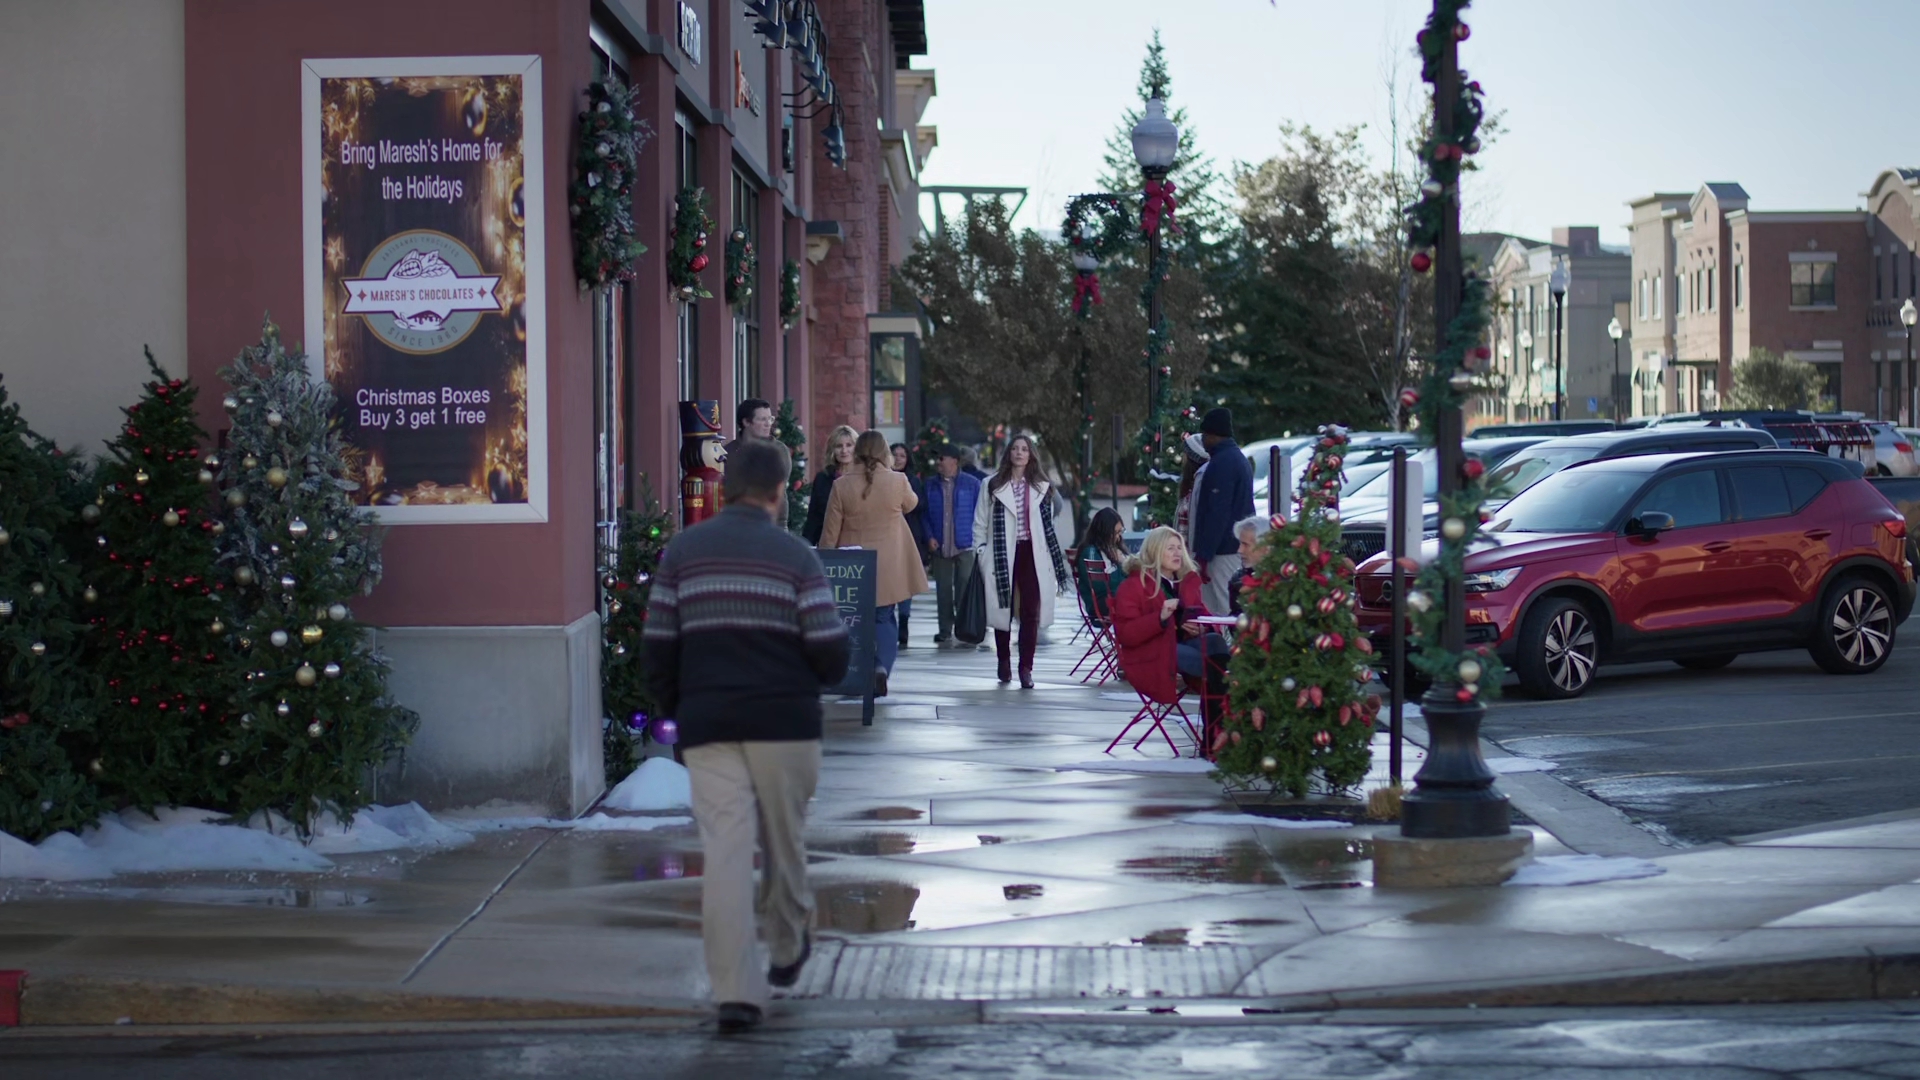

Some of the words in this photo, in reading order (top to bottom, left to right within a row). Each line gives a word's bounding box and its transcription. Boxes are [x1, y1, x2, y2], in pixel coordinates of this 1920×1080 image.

[341, 141, 376, 170] Bring
[379, 138, 438, 164] Maresh's
[442, 138, 481, 163] Home
[484, 136, 503, 161] for
[381, 176, 403, 200] the
[406, 175, 463, 204] Holidays
[370, 289, 416, 302] MARESH'S
[418, 288, 474, 300] CHOCOLATES
[387, 327, 423, 346] SINCE
[356, 389, 436, 406] Christmas
[441, 387, 491, 404] Boxes
[360, 408, 390, 430] Buy
[395, 408, 405, 426] 3
[410, 408, 435, 429] get
[442, 408, 449, 425] 1
[455, 407, 487, 424] free
